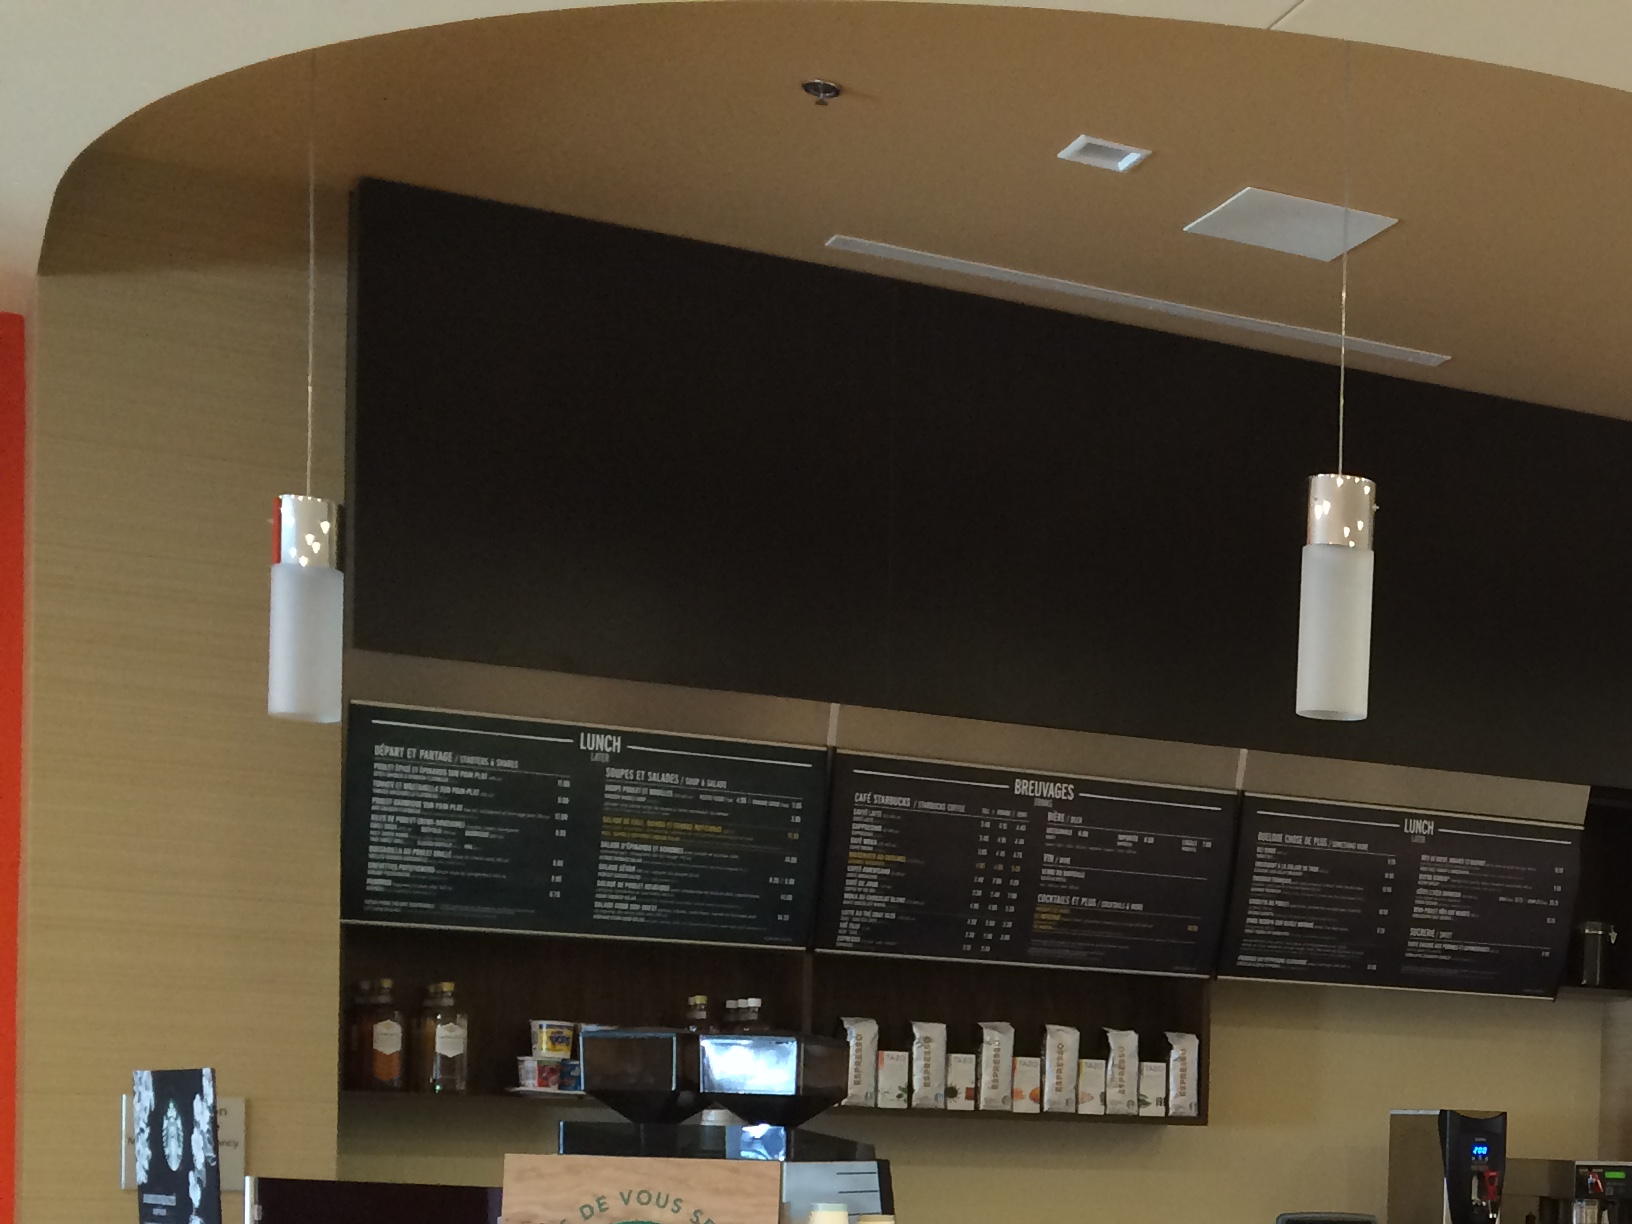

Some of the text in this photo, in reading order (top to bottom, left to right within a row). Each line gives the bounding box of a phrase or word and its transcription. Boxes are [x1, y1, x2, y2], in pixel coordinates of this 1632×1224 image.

[374, 743, 405, 757] DÉPART
[407, 747, 417, 759] ET
[419, 749, 453, 763] PARTAGE
[580, 732, 622, 753] LUNCH
[605, 767, 634, 780] SOUPES
[636, 770, 646, 781] ET
[647, 771, 679, 784] SALADES
[854, 792, 872, 804] CAFÉ
[873, 793, 911, 807] STARBUCKS
[1014, 778, 1075, 801] BREUVAGES
[1404, 818, 1434, 836] LUNCH
[1284, 834, 1303, 845] CHOSE
[1037, 894, 1070, 905] COCKTAILS
[1071, 896, 1080, 906] ET
[1081, 897, 1097, 908] PLUS
[853, 1033, 864, 1086] ESPRESSO
[923, 1035, 932, 1088] ESPRESSO
[991, 1039, 1002, 1091] ESPRESSO
[1055, 1042, 1065, 1093] ESPRESSO
[579, 1194, 609, 1222] DE
[619, 1189, 684, 1215] VOUS
